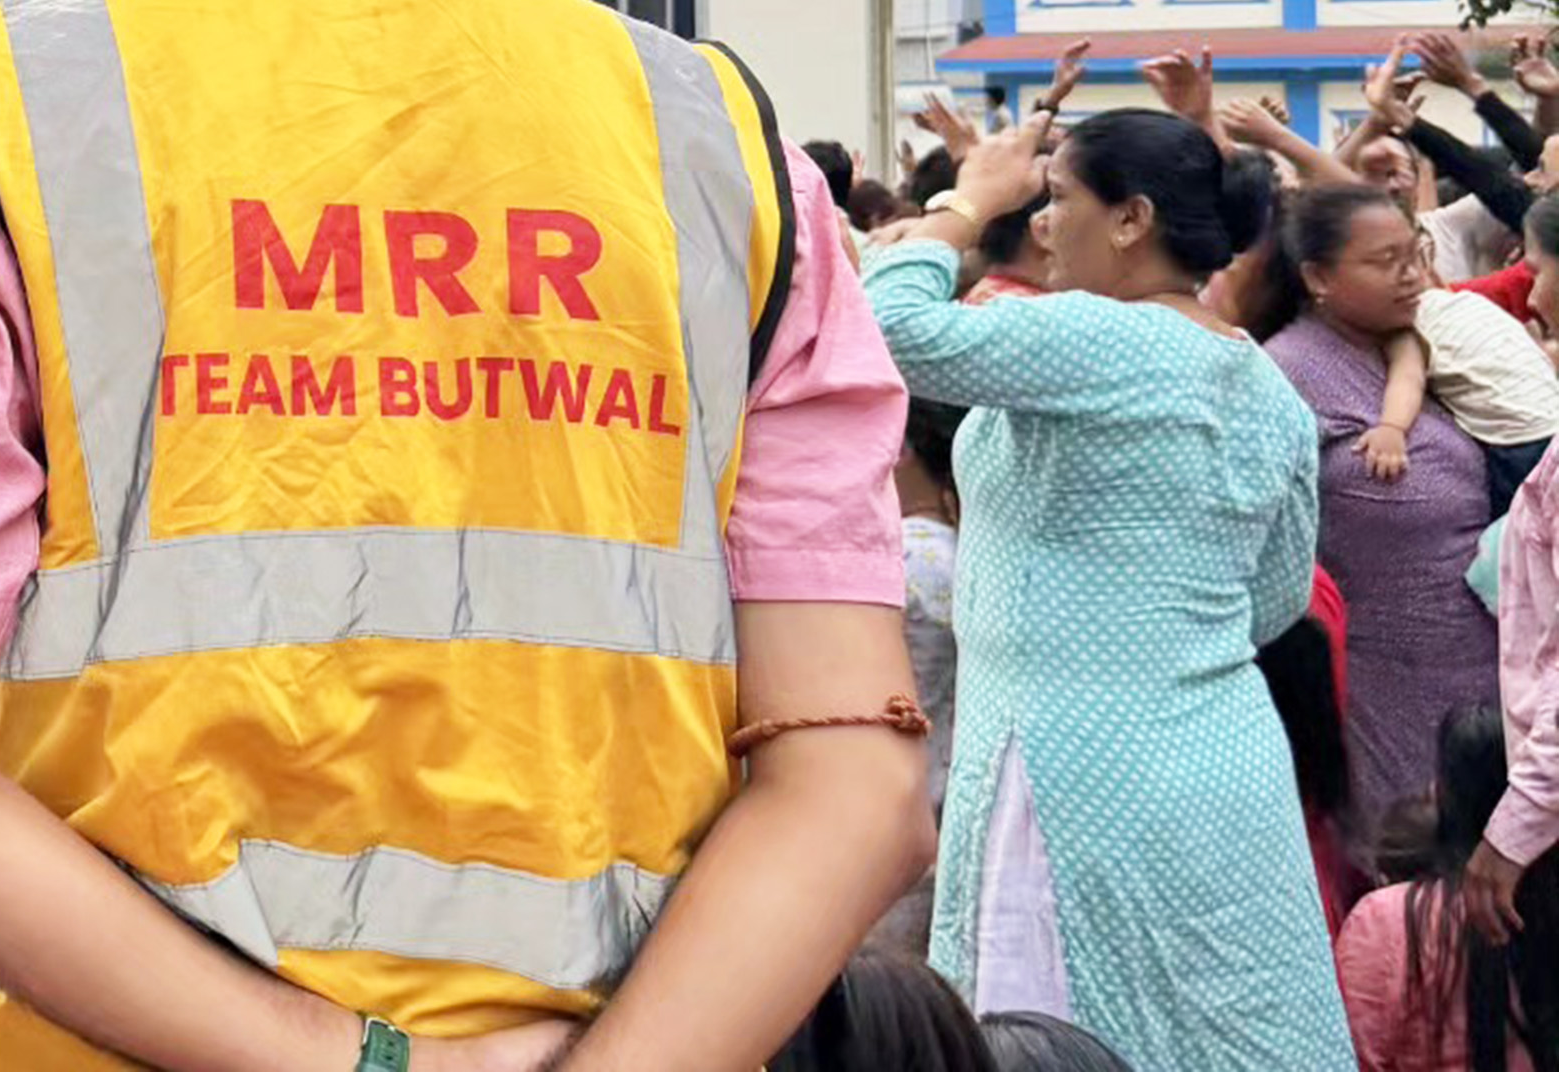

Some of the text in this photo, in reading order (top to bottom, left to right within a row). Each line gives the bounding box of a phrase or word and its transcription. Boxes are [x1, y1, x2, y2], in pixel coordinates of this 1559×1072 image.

[231, 198, 602, 321] MRR
[160, 353, 680, 436] TEAM BUTWAL
